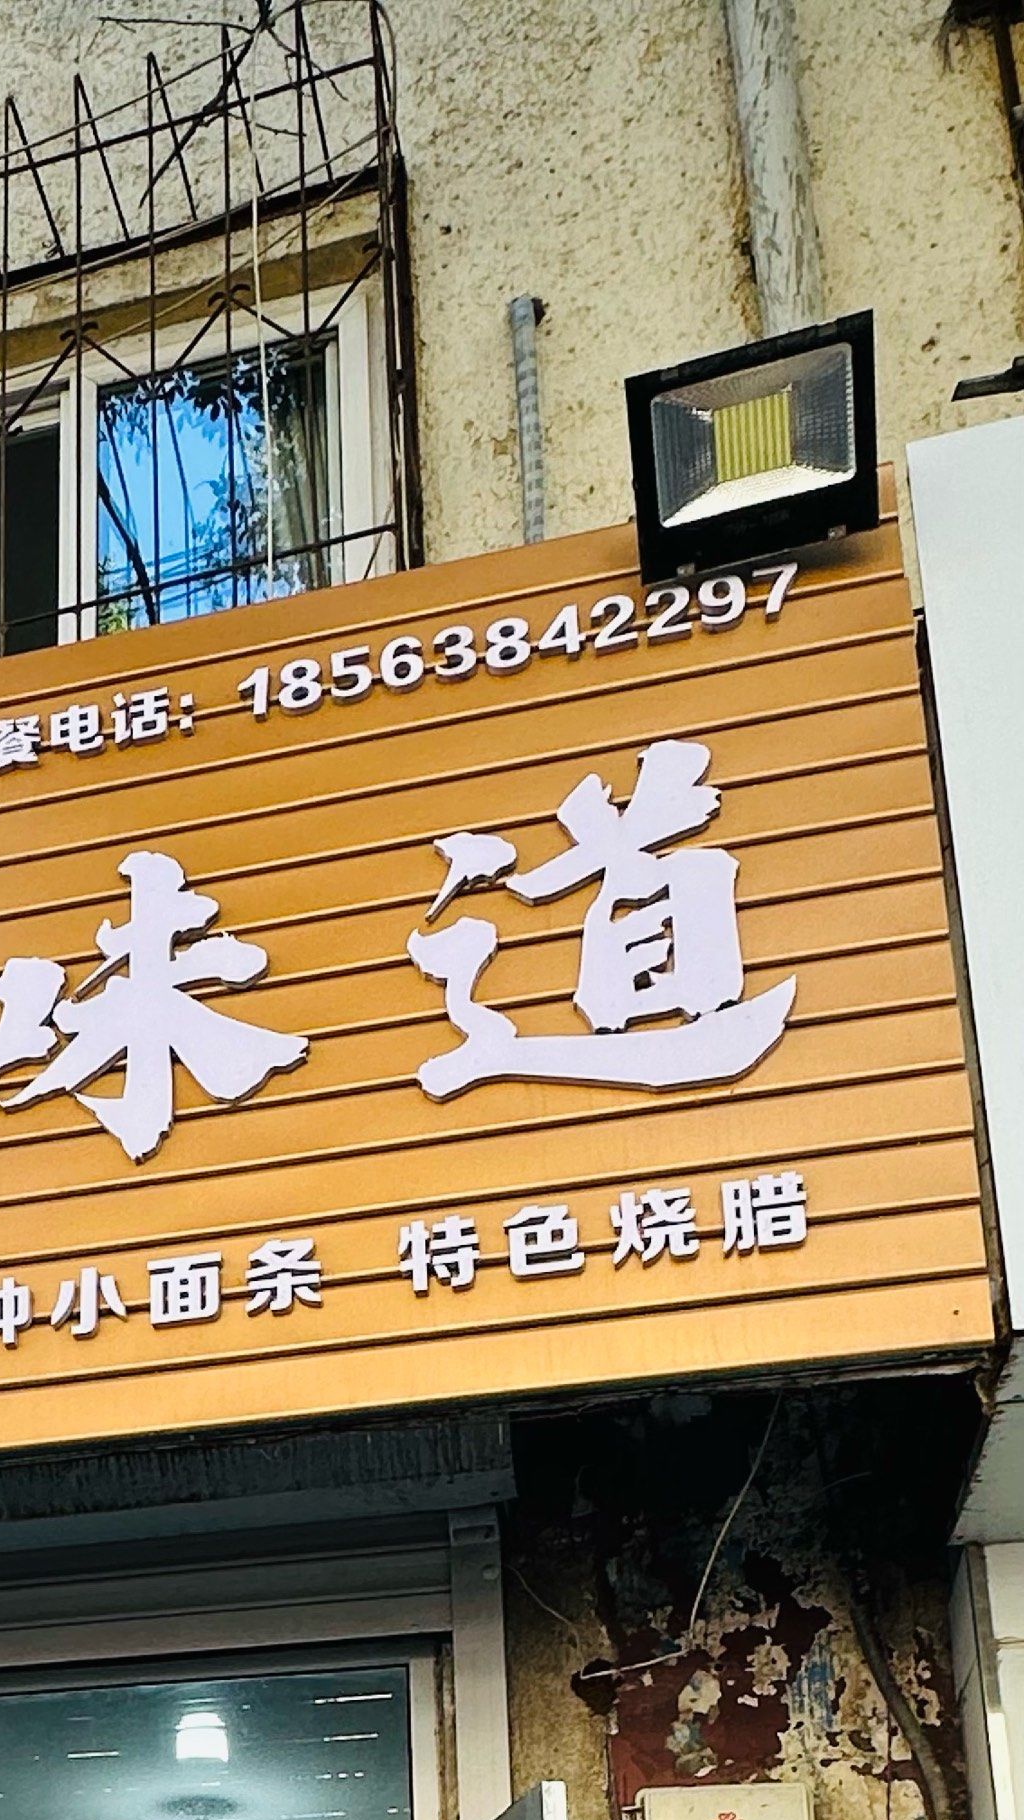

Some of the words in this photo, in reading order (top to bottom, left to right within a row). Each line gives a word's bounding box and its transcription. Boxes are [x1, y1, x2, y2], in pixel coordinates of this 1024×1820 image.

[237, 564, 798, 716] 18563842297
[396, 1171, 810, 1293] 特色烧腊
